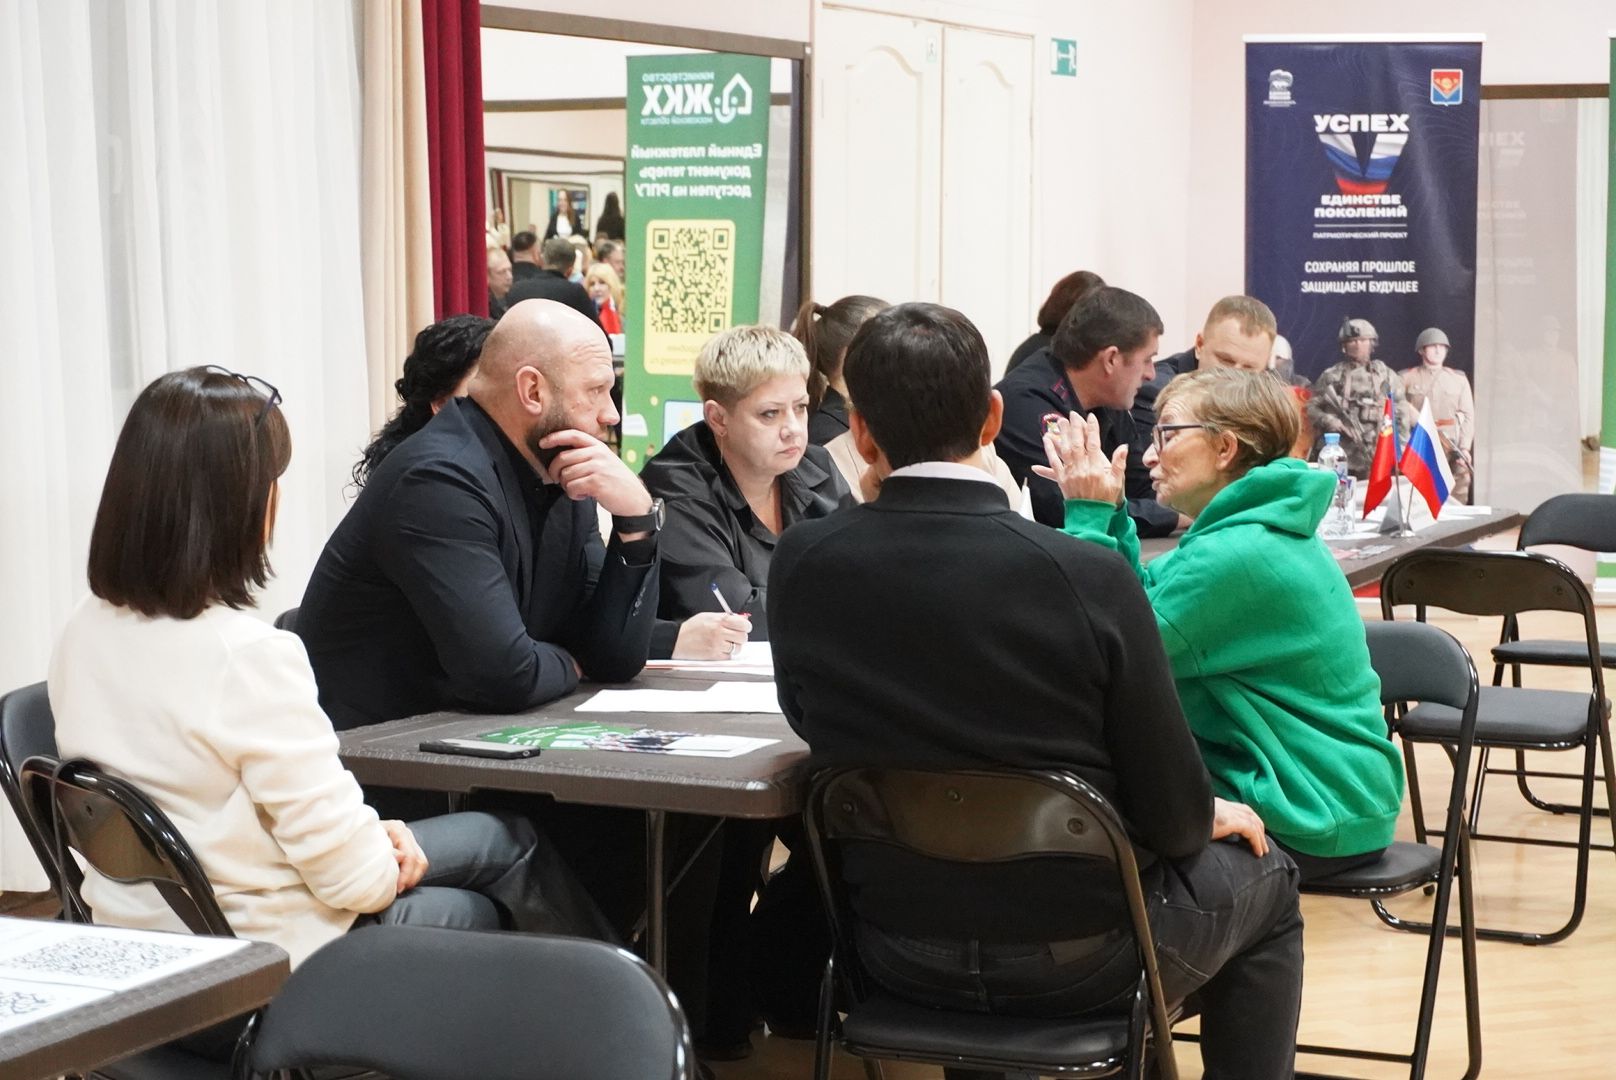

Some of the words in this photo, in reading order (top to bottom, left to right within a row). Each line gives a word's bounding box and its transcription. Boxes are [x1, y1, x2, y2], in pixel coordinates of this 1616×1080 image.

[1313, 114, 1410, 132] УСПЕХ
[1320, 194, 1401, 206] ЕДИНСТВЕ
[1314, 205, 1408, 218] ПОКОЛЕНИЙ
[1304, 261, 1360, 273] СОХРАНЯЯ
[1361, 261, 1416, 273] ПРОШЛОЕ
[1301, 281, 1367, 294] ЗАЩИЩАЕМ
[1368, 281, 1419, 294] БУДУЩЕЕ
